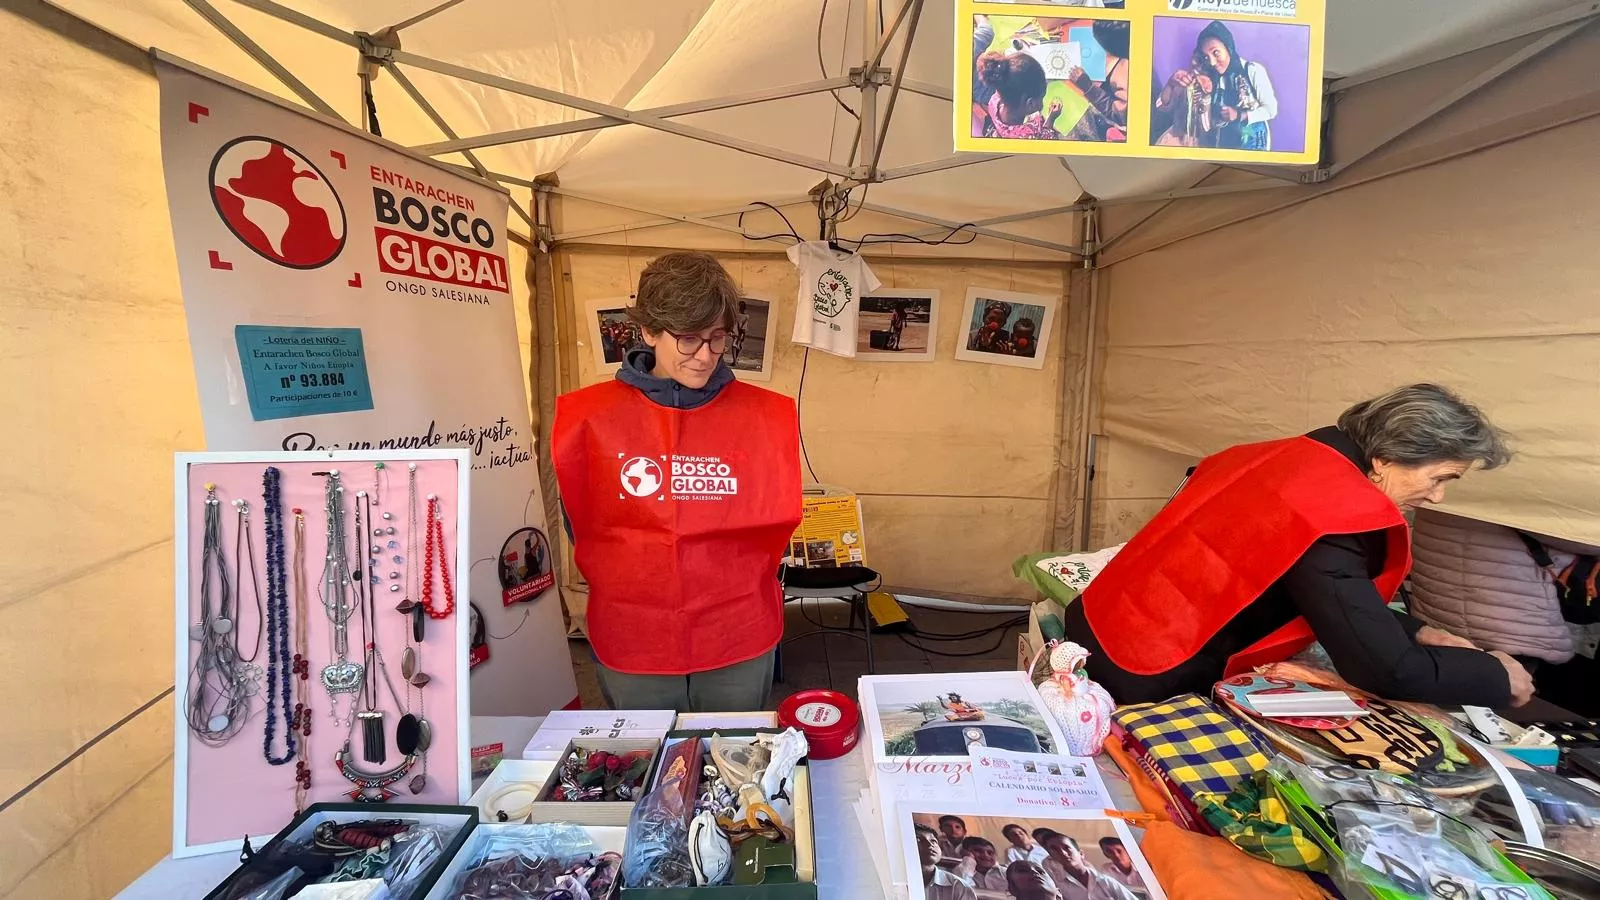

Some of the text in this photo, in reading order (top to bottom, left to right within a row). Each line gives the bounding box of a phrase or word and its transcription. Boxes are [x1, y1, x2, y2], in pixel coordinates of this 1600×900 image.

[370, 165, 475, 212] ENTARACHEN
[372, 186, 494, 248] BOSCO
[380, 234, 507, 289] GLOBAL
[386, 280, 490, 305] ONGD SALESIANA
[301, 335, 315, 345] del
[317, 335, 340, 344] NIÑO
[253, 348, 360, 359] Entarachen Bosco Global
[263, 363, 272, 371] A
[274, 362, 298, 370] favor
[301, 361, 326, 369] Niños
[280, 373, 345, 388] nº 93.884
[270, 391, 331, 403] Participaciones
[379, 420, 443, 450] mundo
[446, 424, 475, 446] más
[671, 454, 720, 463] ENTARACHEN
[671, 462, 731, 477] BOSCO
[672, 478, 735, 492] GLOBAL
[507, 574, 551, 597] VOLUNTARIADO
[989, 781, 1098, 796] CALENDARIO SOLIDARIO
[1060, 796, 1070, 806] 8
